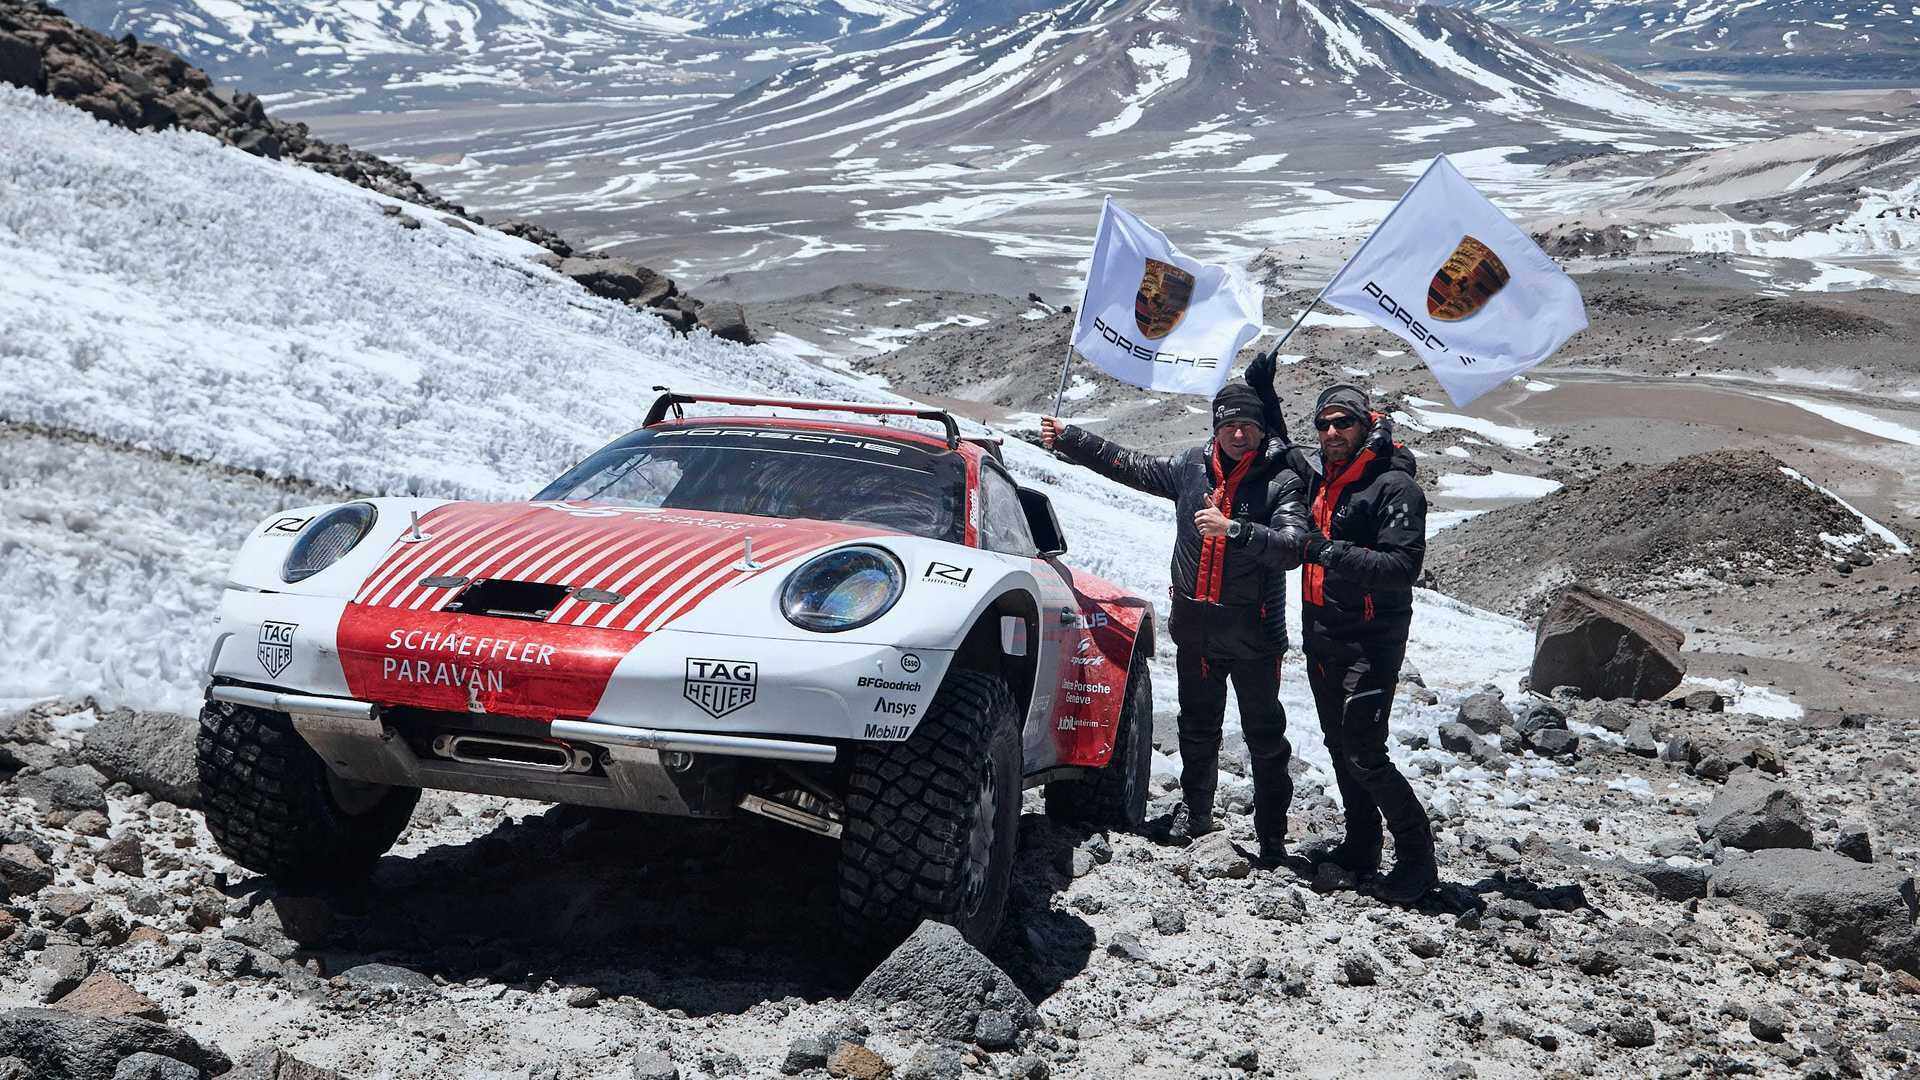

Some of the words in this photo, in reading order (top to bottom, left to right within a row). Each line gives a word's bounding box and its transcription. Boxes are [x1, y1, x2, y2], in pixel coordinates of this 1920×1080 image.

[1362, 281, 1476, 366] PORSC
[1093, 317, 1218, 369] PORSCHE
[653, 428, 901, 456] PORSCHE
[264, 624, 291, 642] TAG
[259, 646, 290, 673] HEUER
[385, 629, 556, 666] SCHAEFFLER
[692, 661, 751, 681] TAG
[903, 657, 918, 668] Esso
[383, 657, 503, 693] PARAVAN
[857, 676, 921, 692] BFGoodrich
[1074, 680, 1111, 694] Porsche
[689, 683, 752, 714] HEUER
[873, 696, 917, 718] Ansys
[864, 724, 898, 739] Mobil
